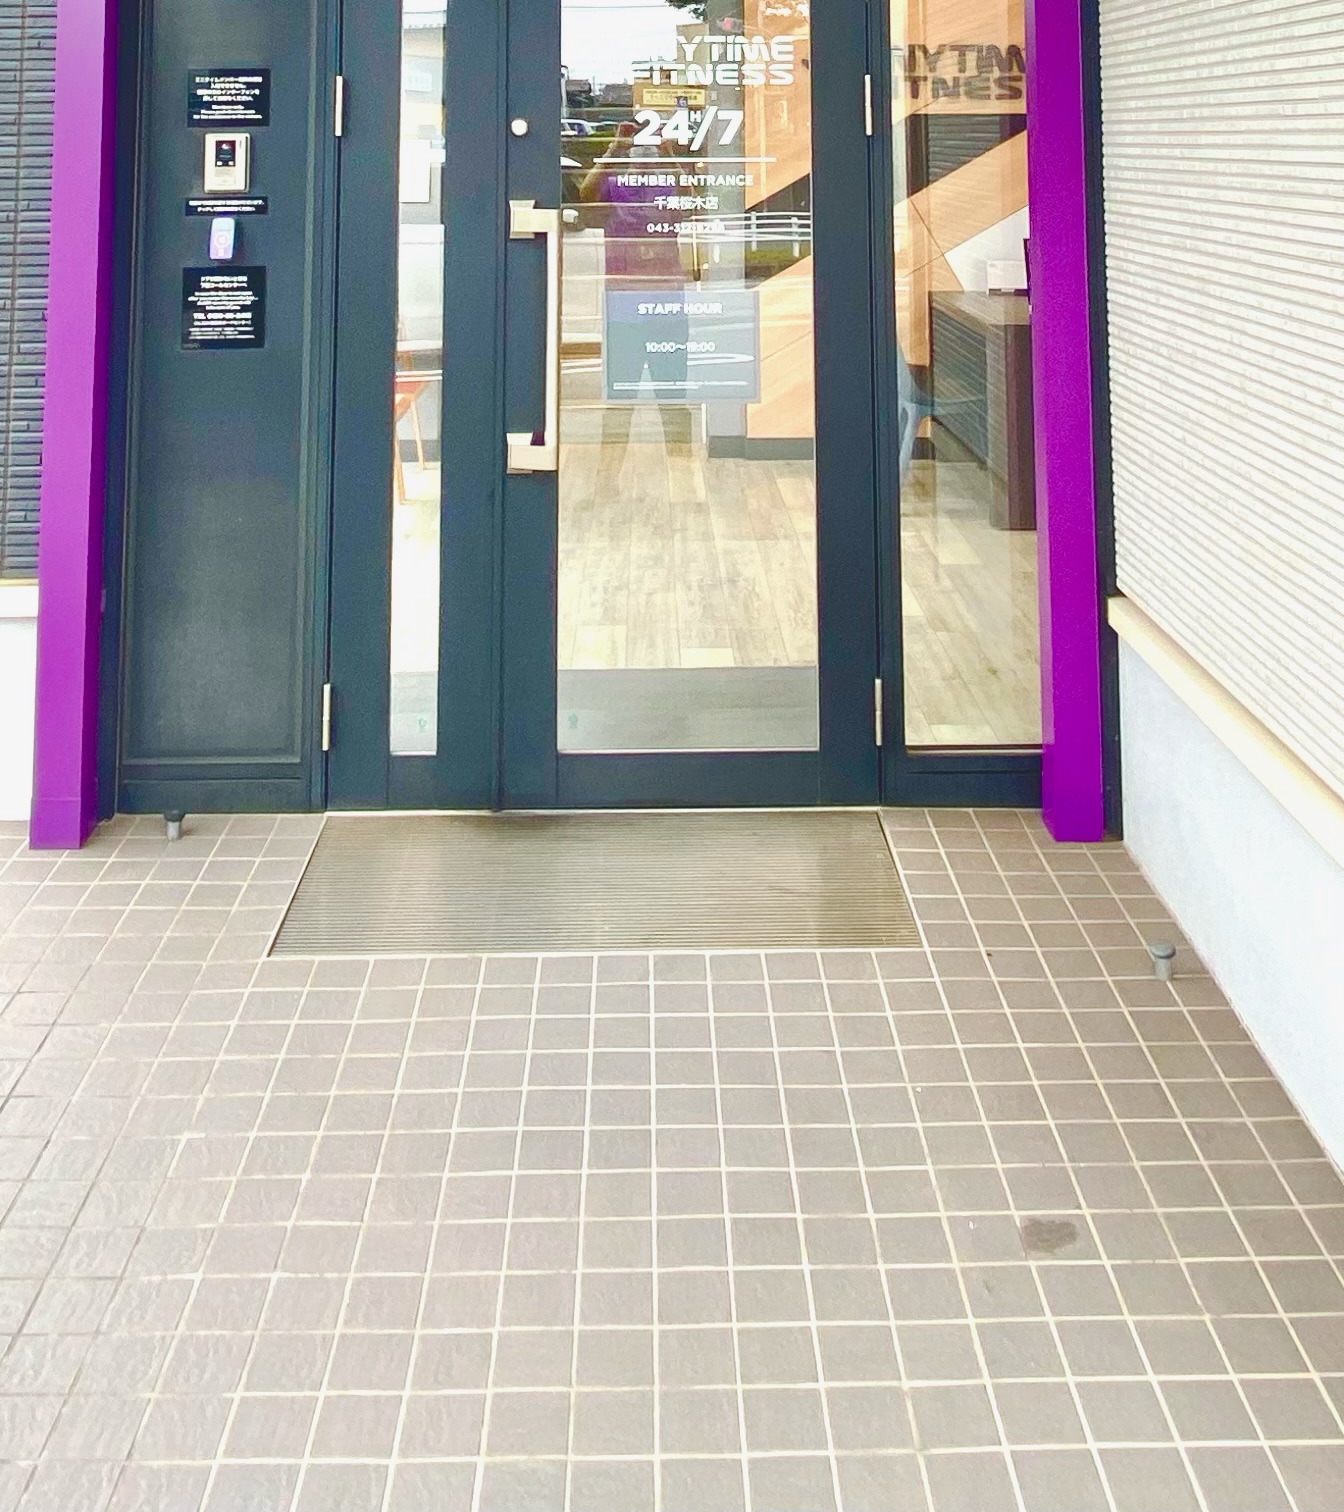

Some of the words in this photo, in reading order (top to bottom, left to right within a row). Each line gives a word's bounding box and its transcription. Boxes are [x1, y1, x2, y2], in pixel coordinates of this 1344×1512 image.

[628, 63, 794, 85] FITNESS
[617, 174, 675, 187] MEMBER
[680, 175, 754, 187] ENTRANCE
[637, 303, 681, 315] STAFF
[684, 303, 723, 315] HOUR
